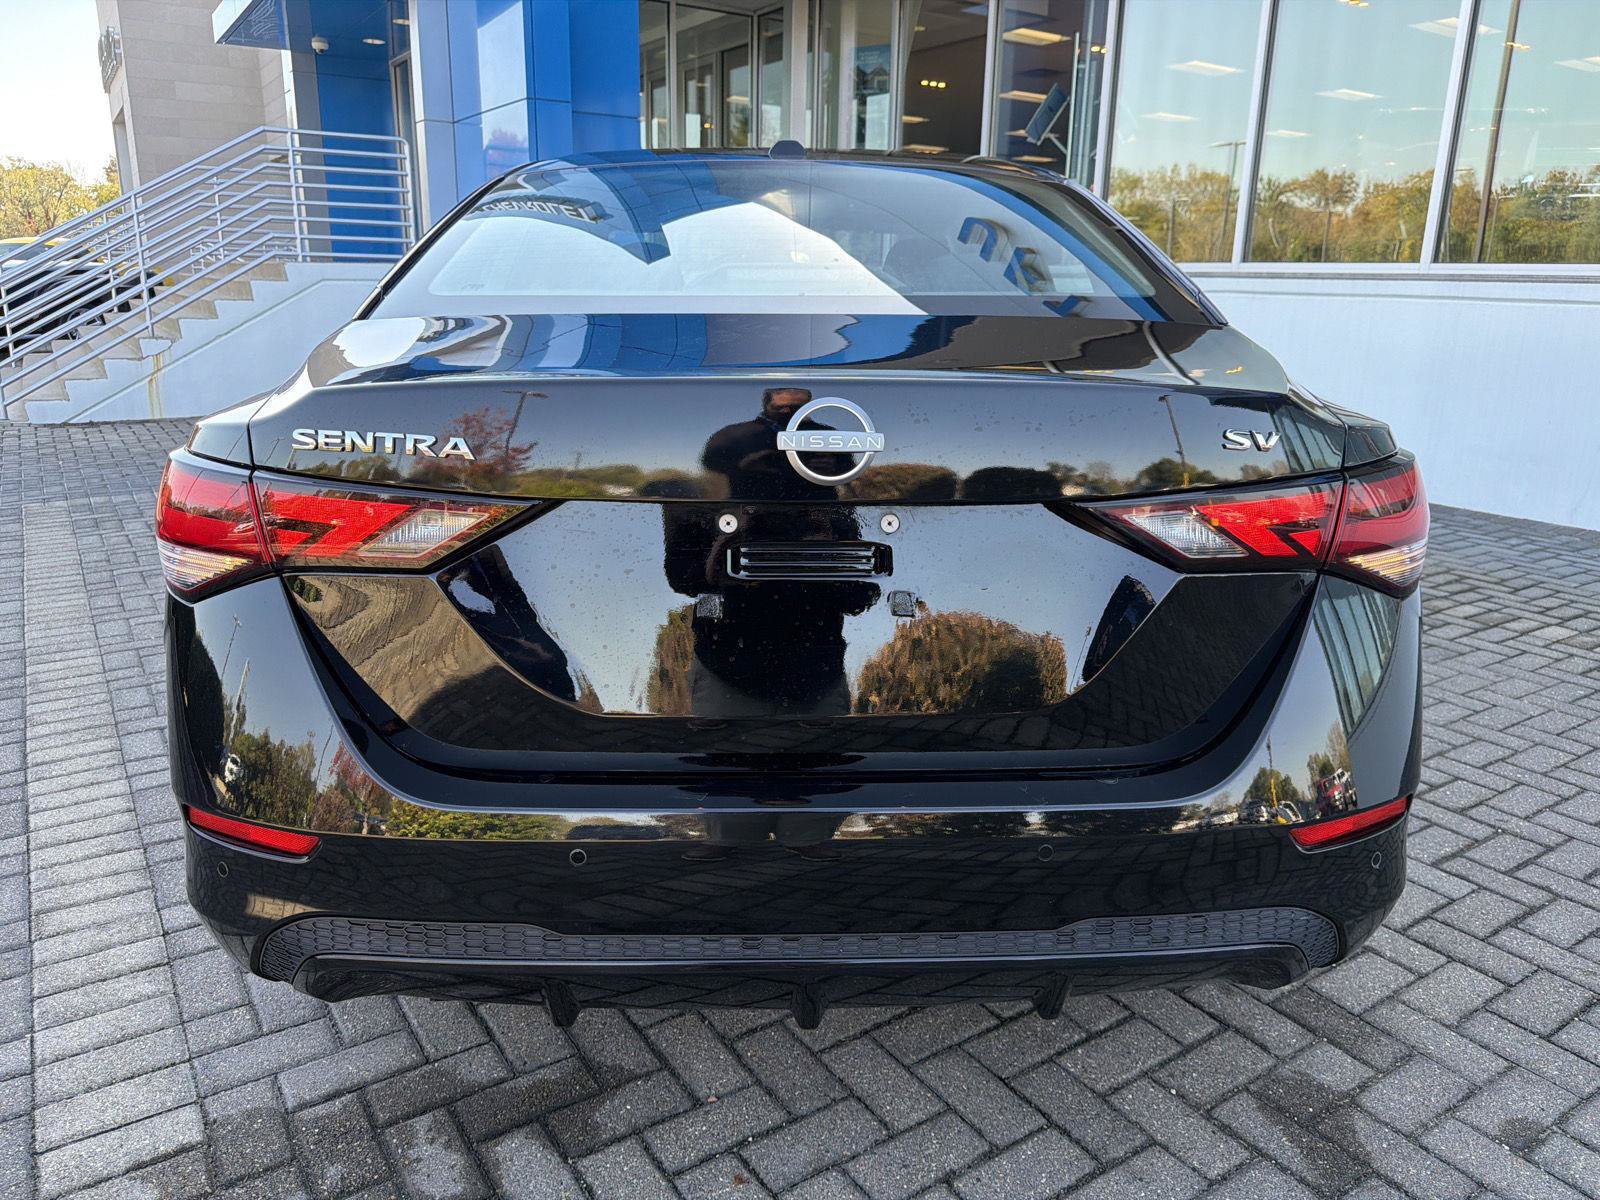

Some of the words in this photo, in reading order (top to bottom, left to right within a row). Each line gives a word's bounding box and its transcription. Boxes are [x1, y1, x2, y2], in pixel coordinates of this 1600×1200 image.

[291, 428, 477, 461] SENTRA
[780, 435, 881, 449] NISSAN
[1221, 428, 1280, 452] SV
